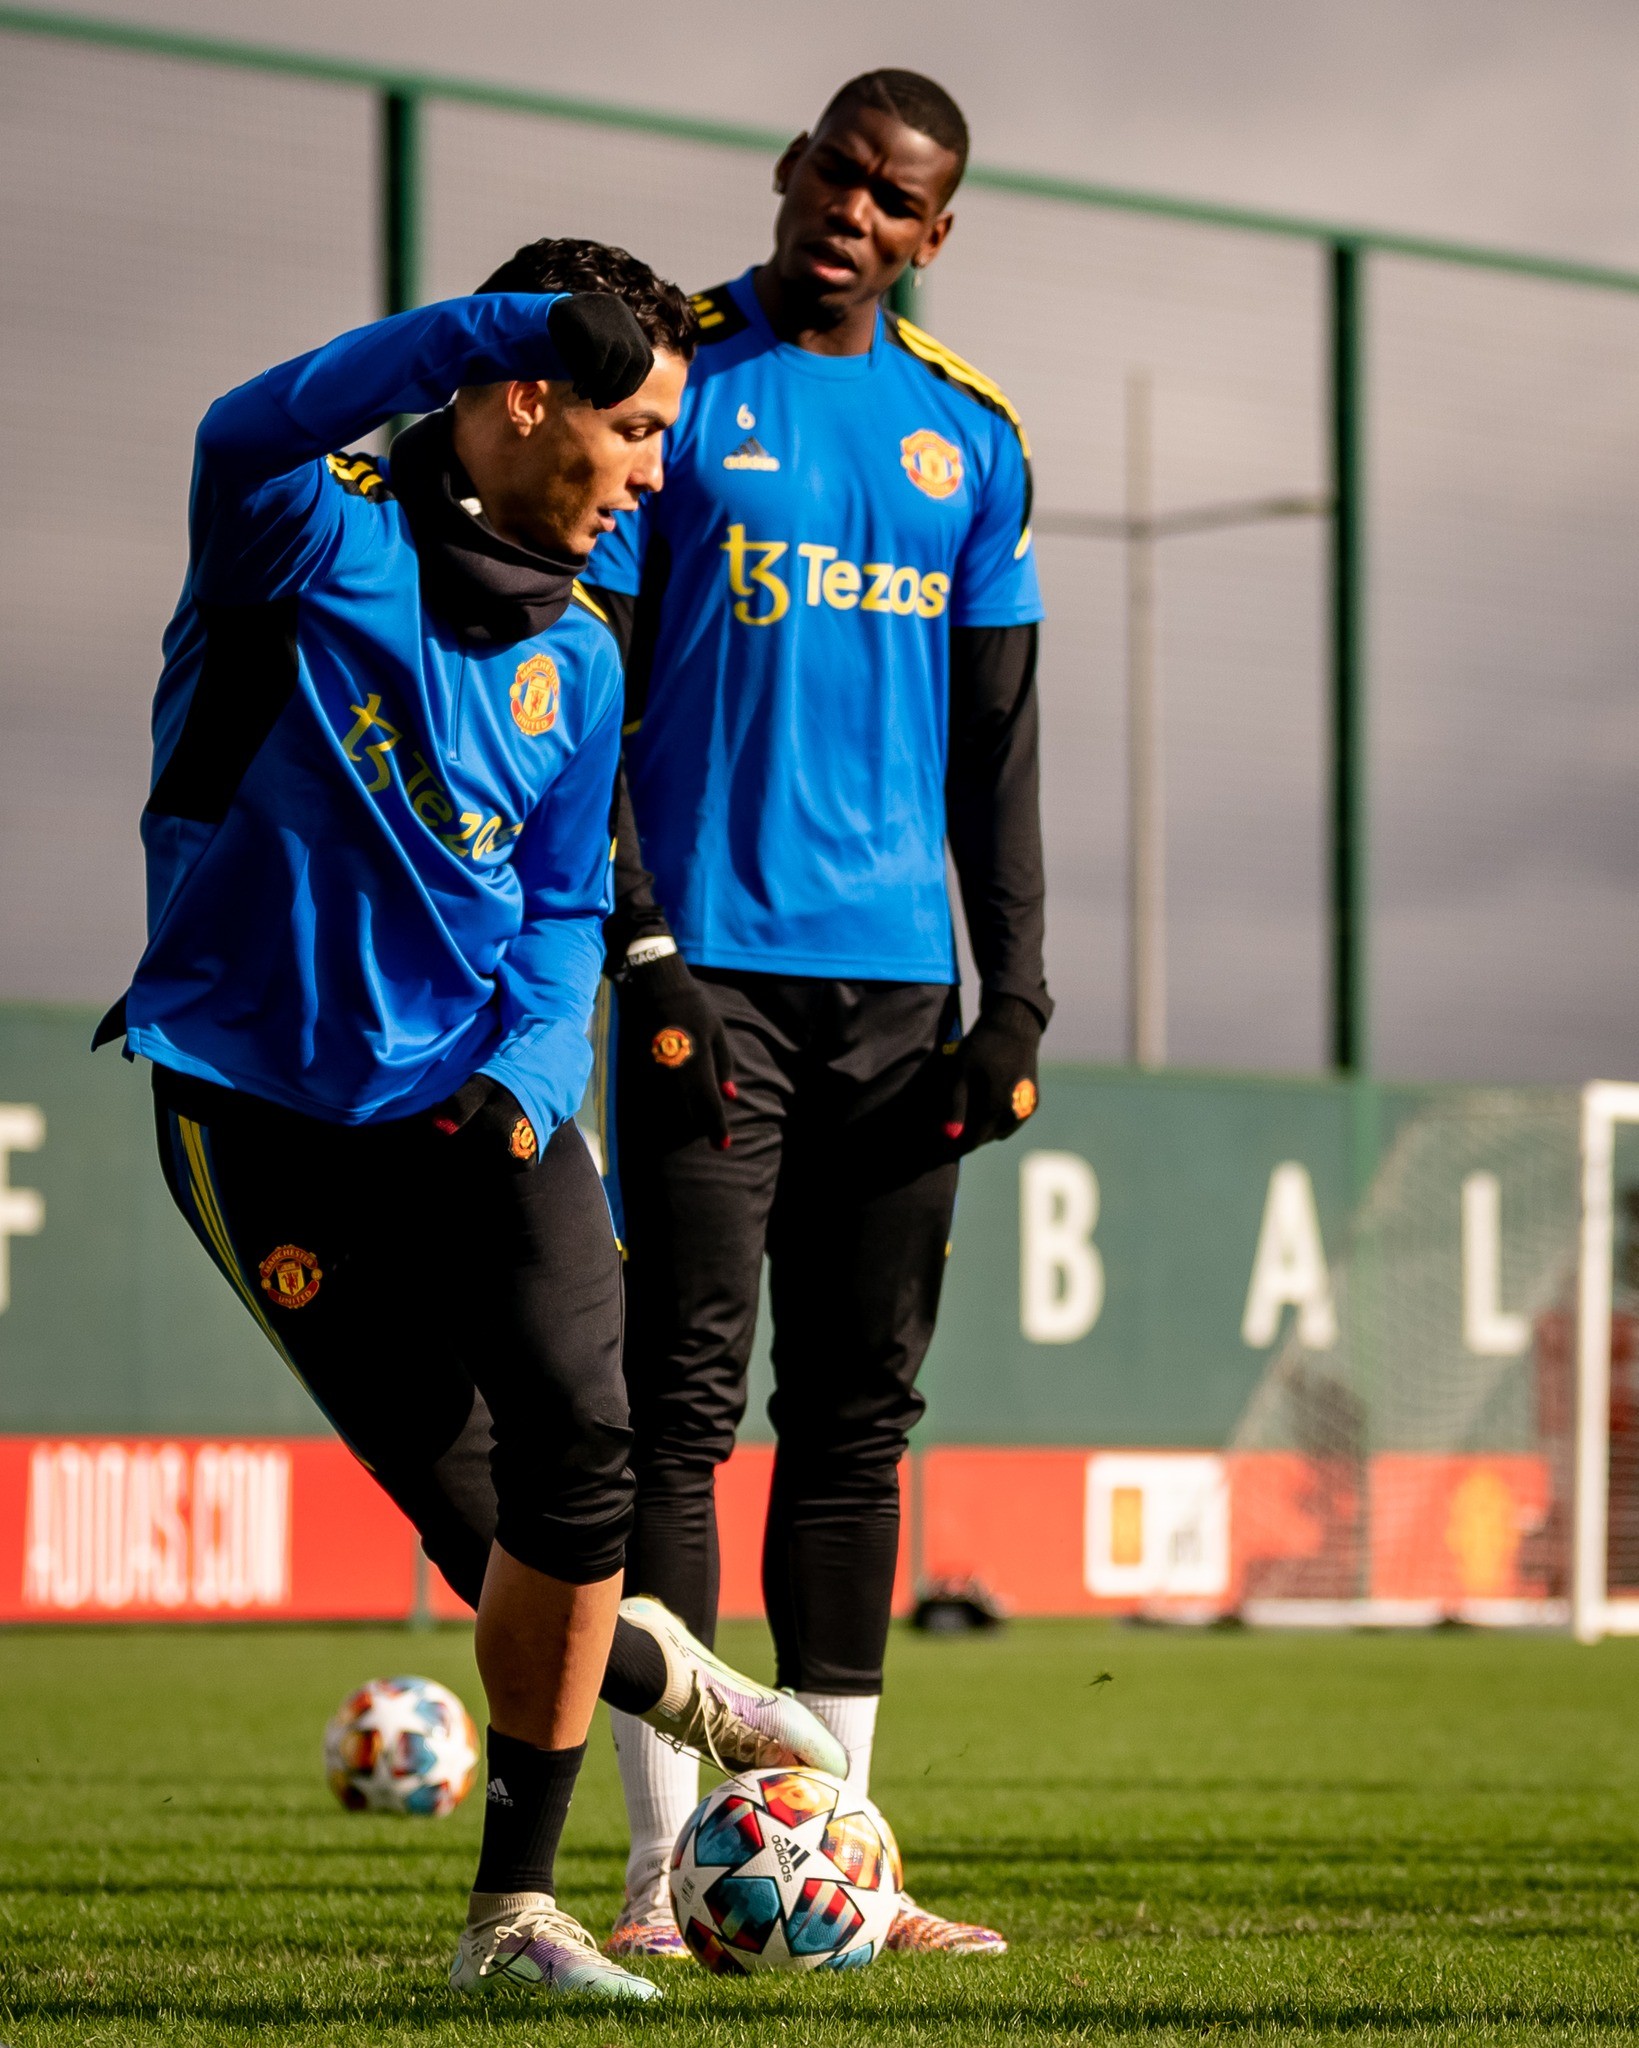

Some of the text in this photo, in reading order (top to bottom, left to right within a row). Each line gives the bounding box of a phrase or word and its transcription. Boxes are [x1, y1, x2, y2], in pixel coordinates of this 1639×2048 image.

[736, 403, 756, 430] 6
[797, 542, 951, 618] Tezos
[516, 712, 549, 731] UNITED
[264, 1249, 314, 1274] MANCHESTER
[278, 1289, 312, 1305] UNITED
[771, 1834, 793, 1883] adidas
